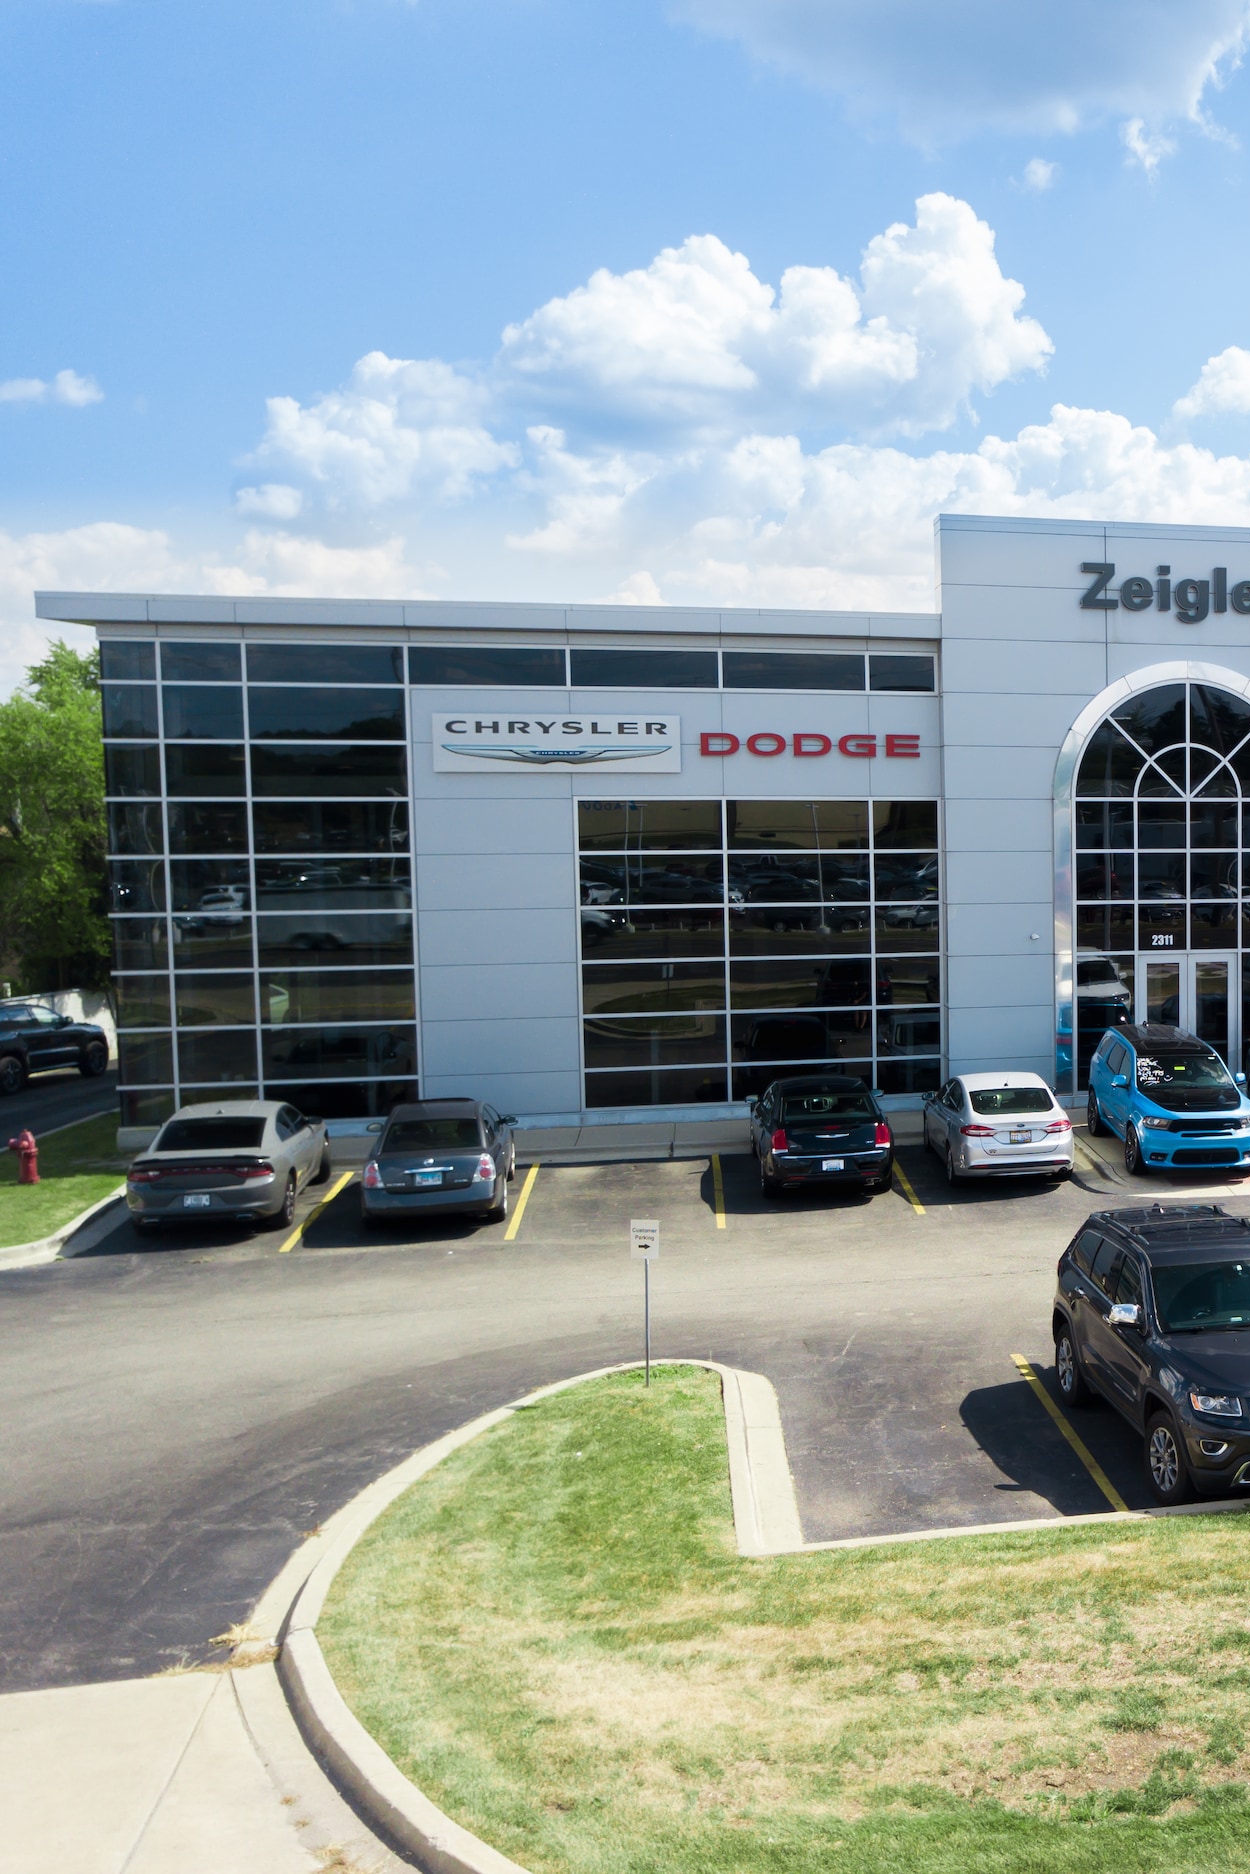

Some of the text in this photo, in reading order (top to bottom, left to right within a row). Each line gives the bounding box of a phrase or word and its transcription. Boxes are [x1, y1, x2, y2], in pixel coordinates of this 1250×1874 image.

[445, 720, 668, 735] CHRYSLER
[700, 732, 921, 758] DODGE
[1151, 934, 1174, 946] 2311
[634, 1234, 655, 1242] Parking
